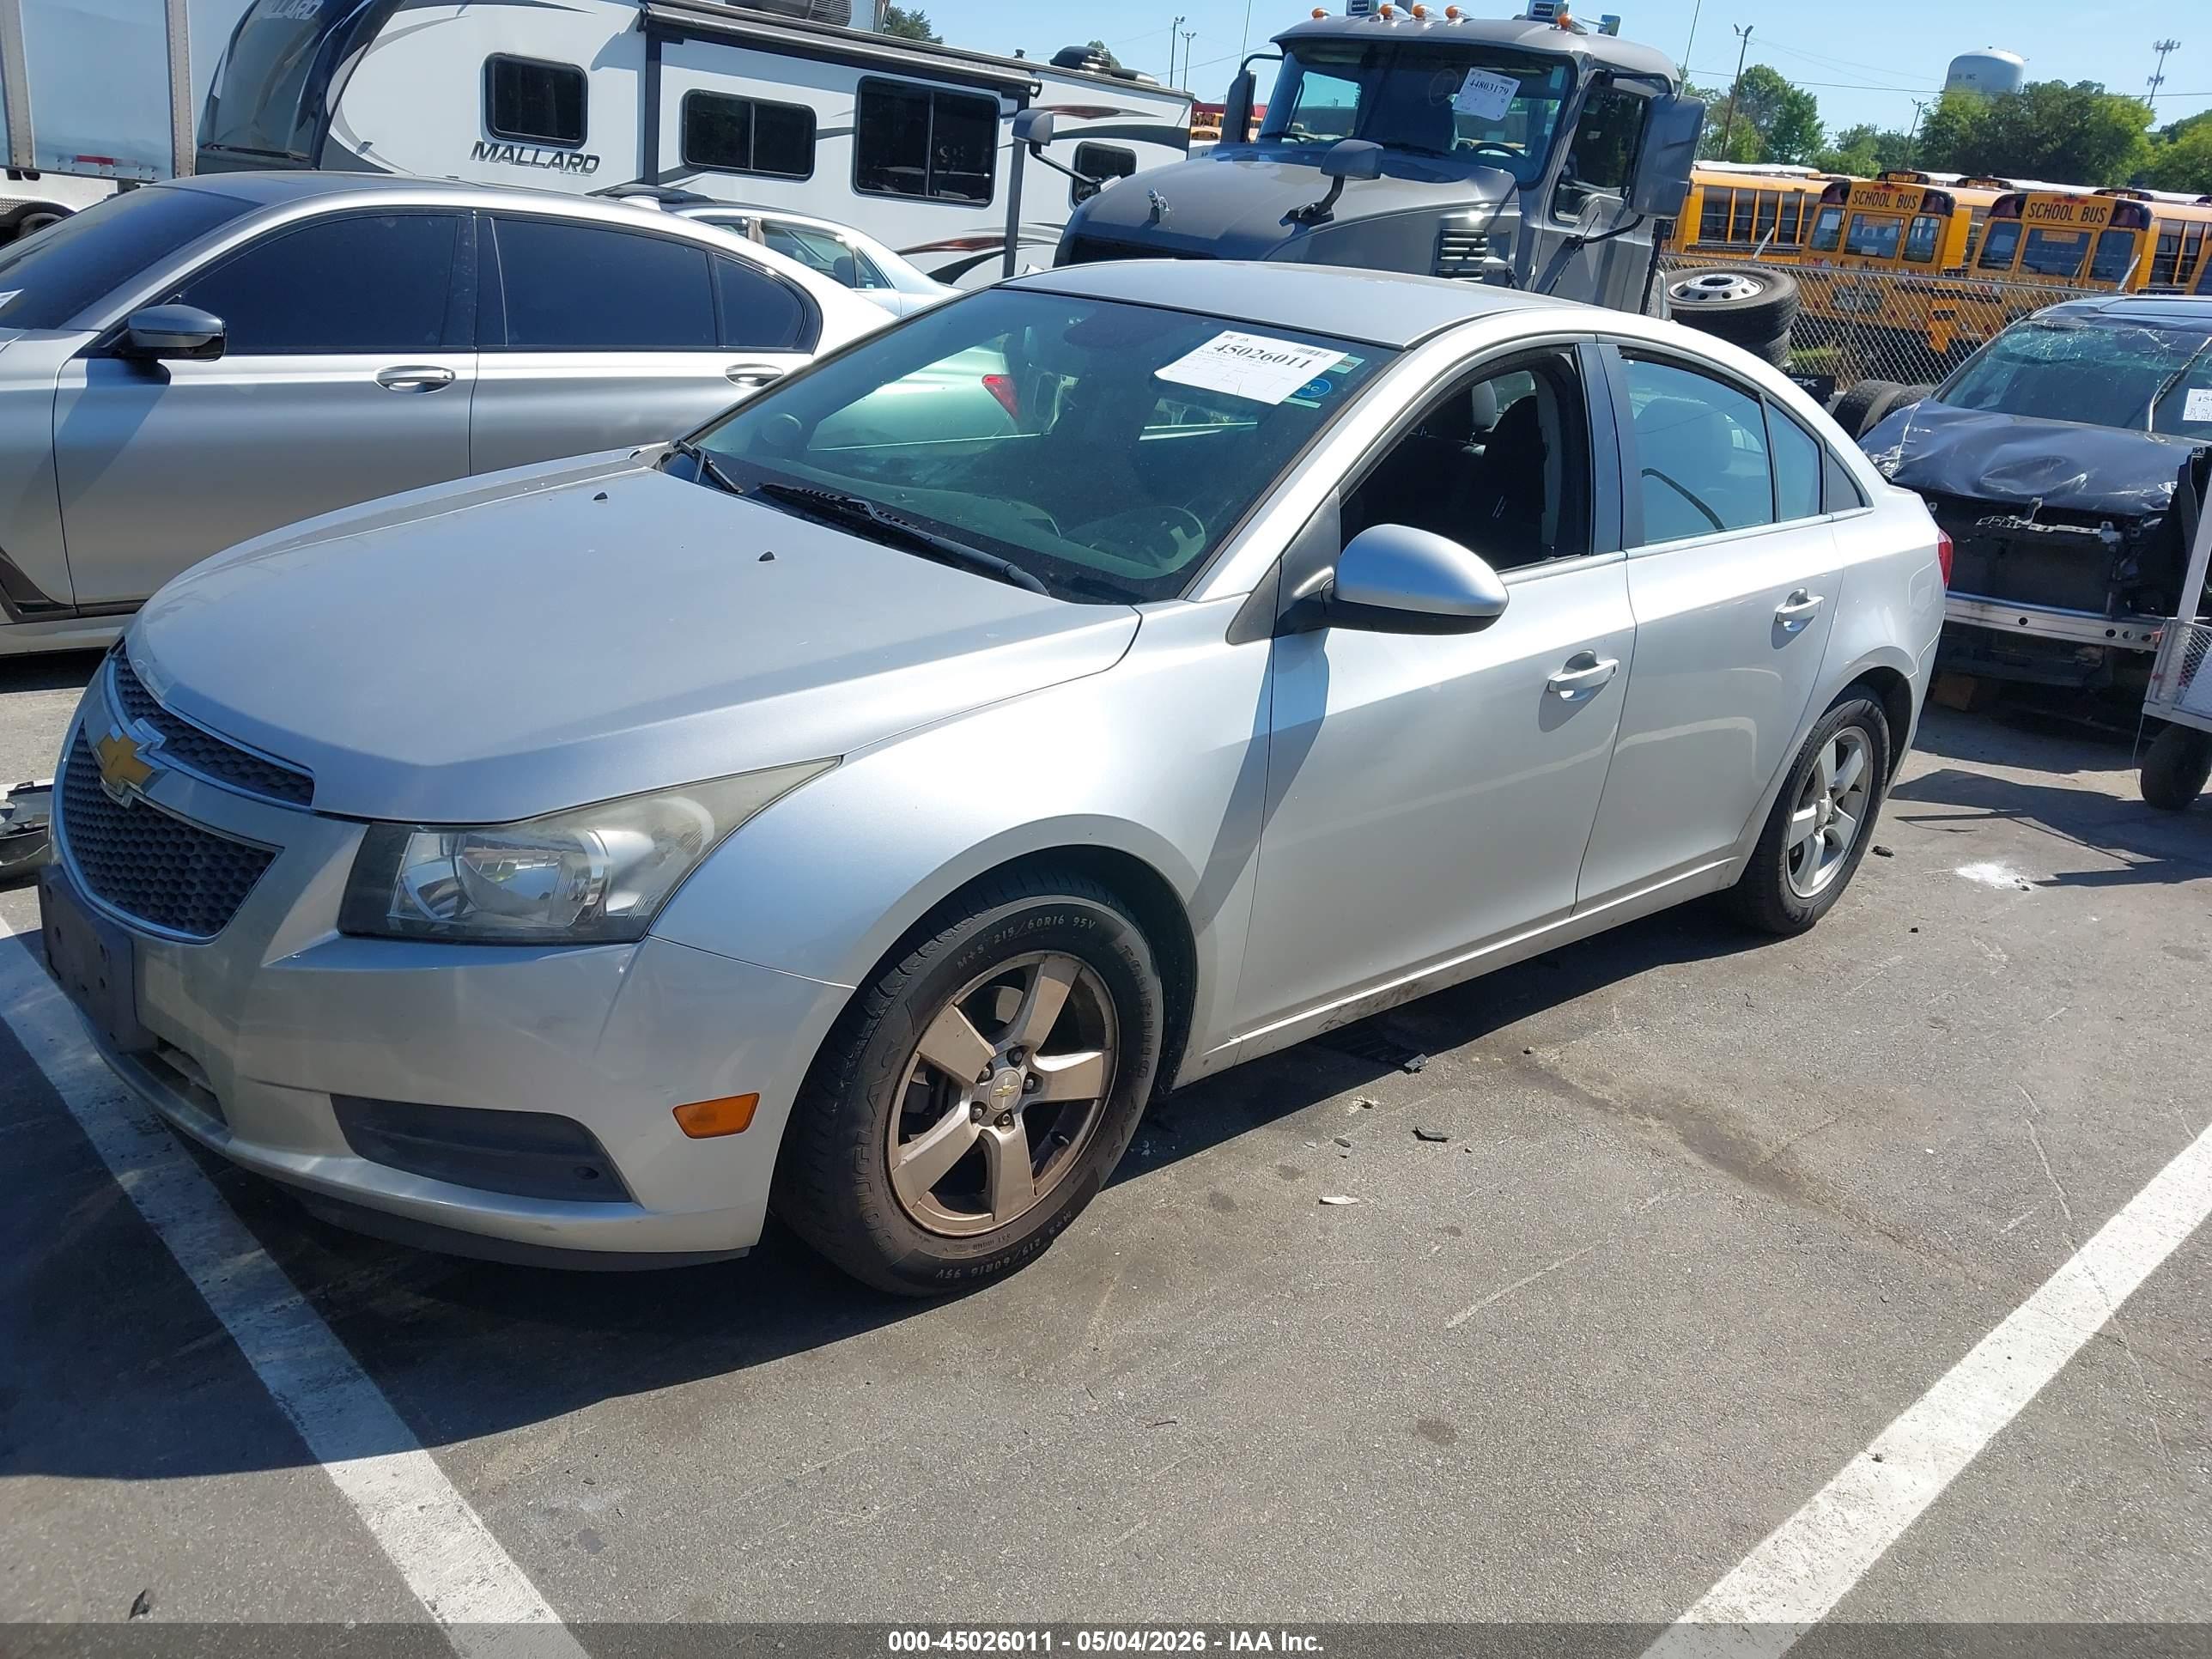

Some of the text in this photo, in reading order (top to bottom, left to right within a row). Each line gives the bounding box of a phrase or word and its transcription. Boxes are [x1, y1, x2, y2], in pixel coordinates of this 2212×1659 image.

[470, 141, 600, 174] MALLARD
[1852, 190, 1918, 209] SCHOOL BUS
[2027, 203, 2107, 223] SCHOOL BUS
[1214, 343, 1312, 368] 45026011
[994, 914, 1066, 945] 215/60R16
[1073, 916, 1097, 930] 95V
